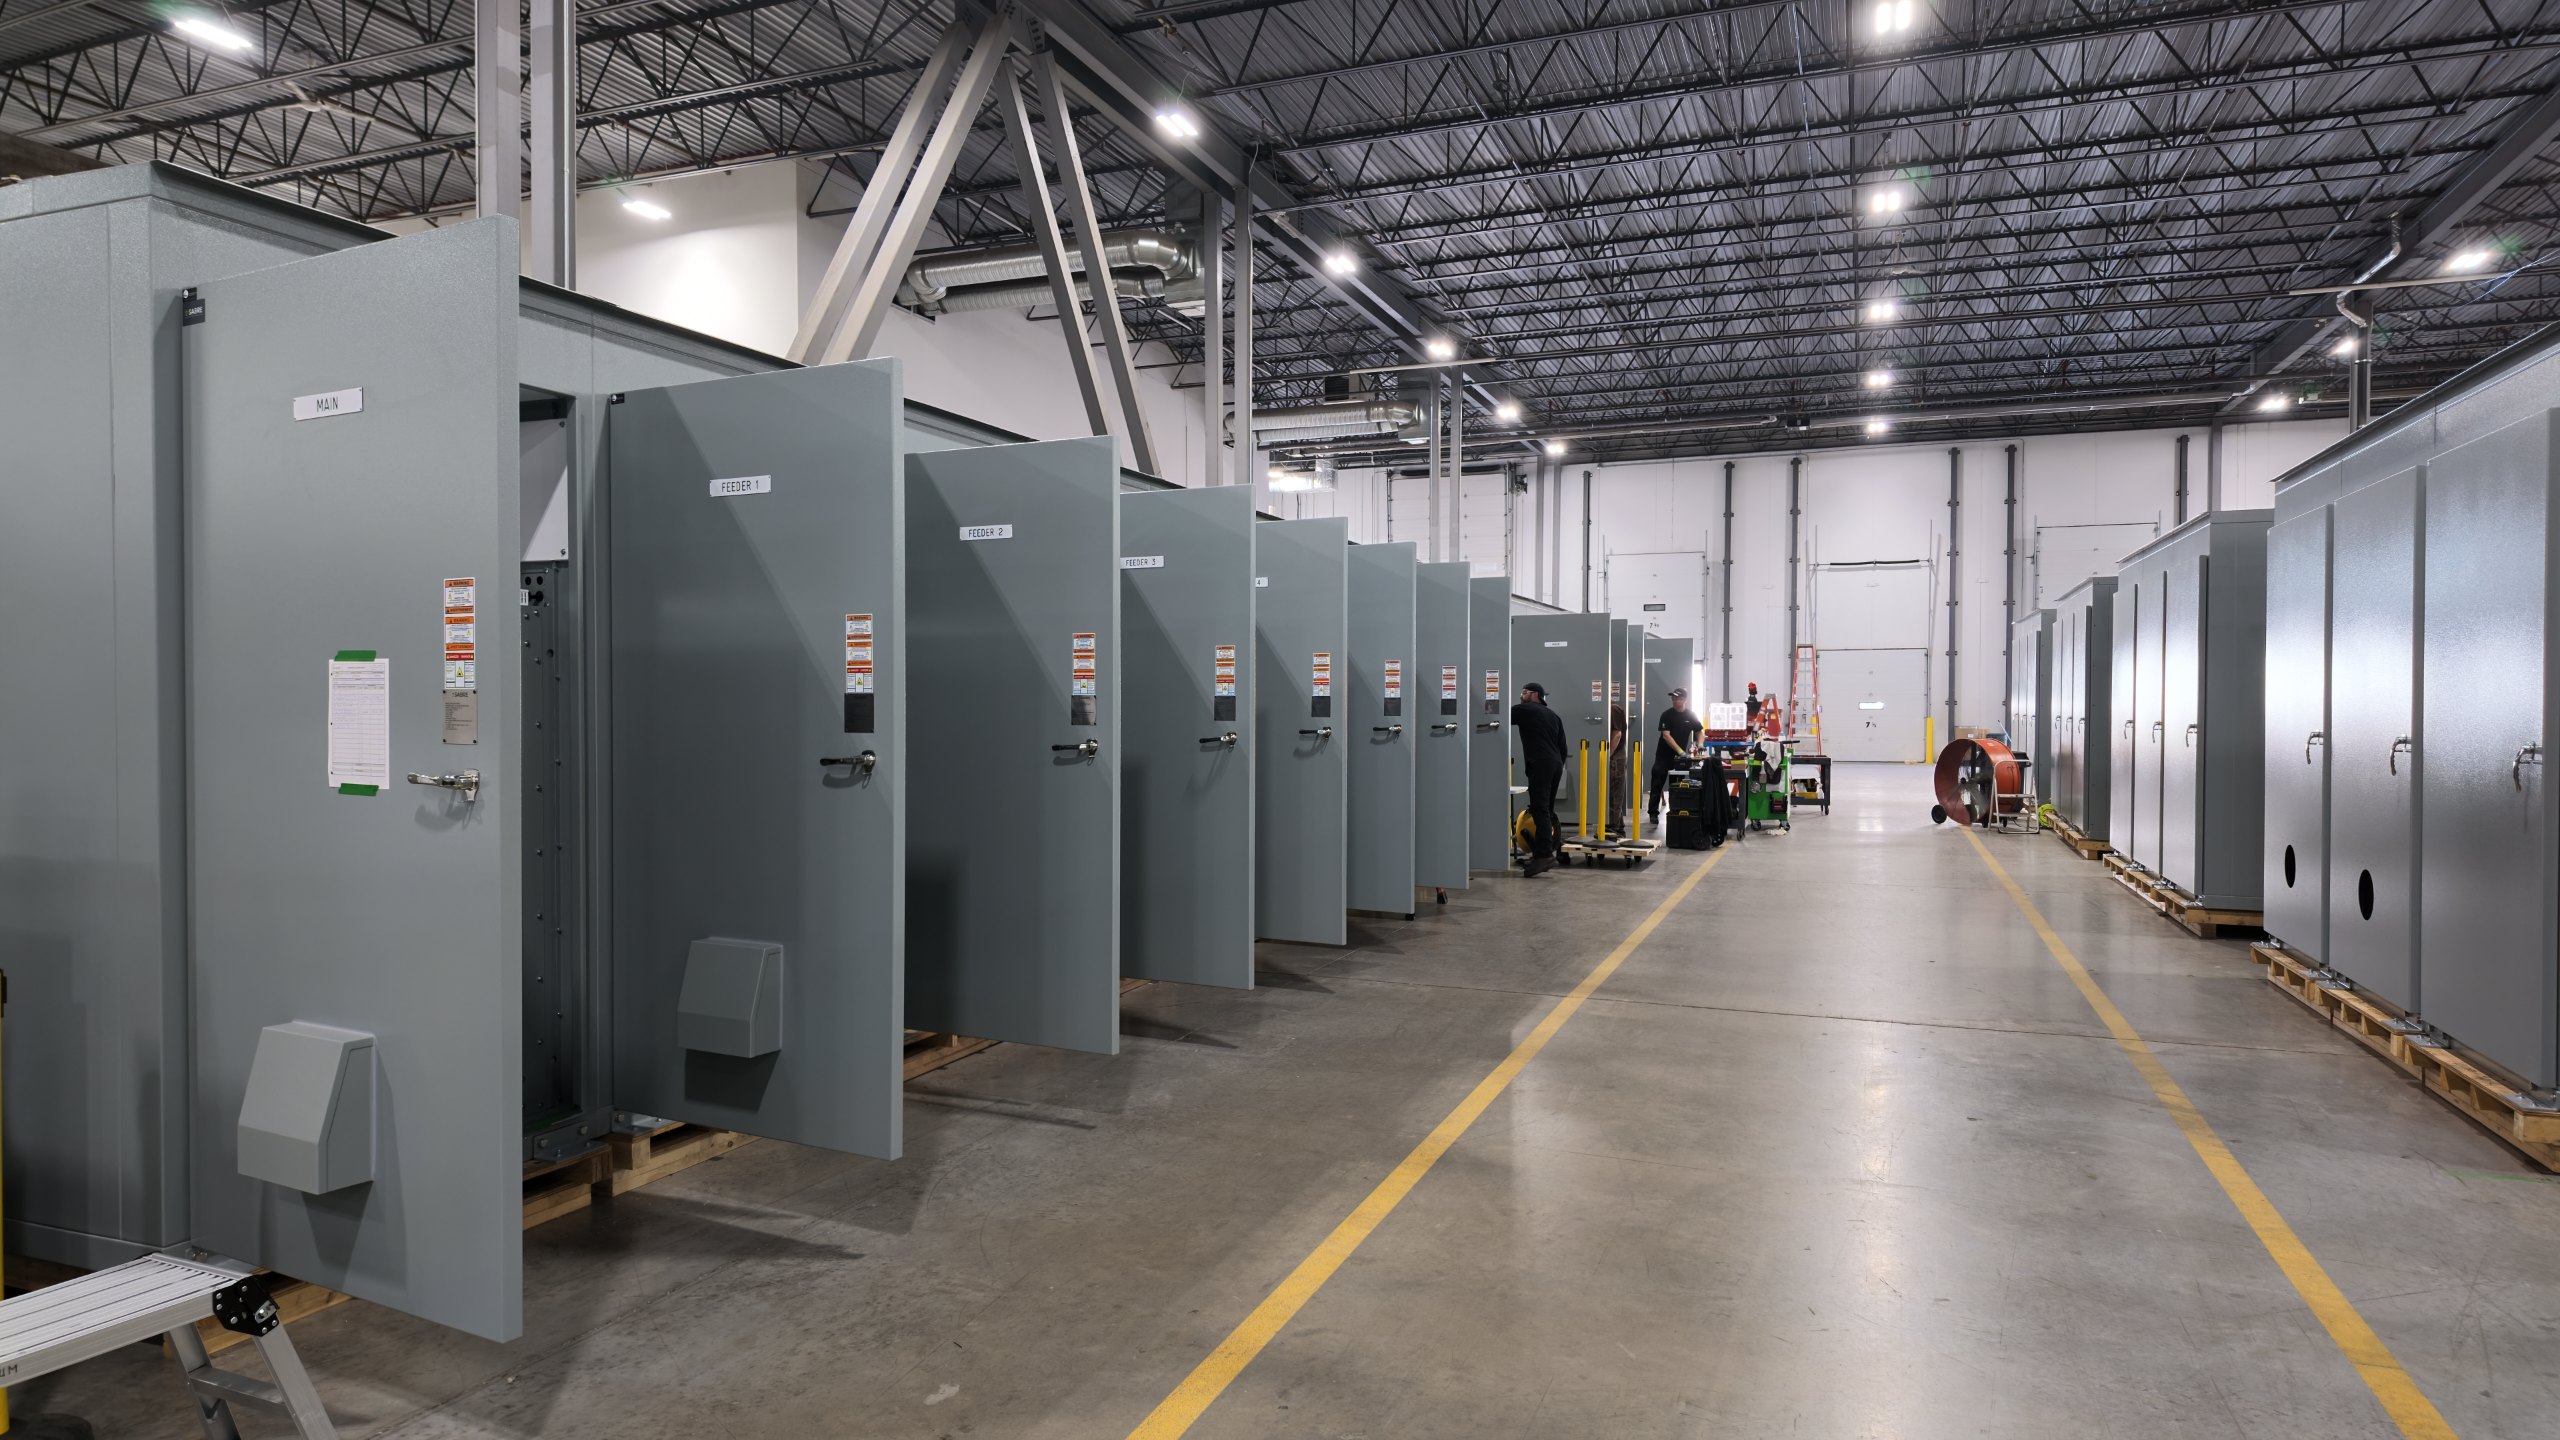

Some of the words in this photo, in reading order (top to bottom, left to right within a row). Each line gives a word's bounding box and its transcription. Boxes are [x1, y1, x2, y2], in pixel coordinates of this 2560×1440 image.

[188, 306, 203, 316] SABRE
[316, 396, 339, 413] MAIN
[721, 480, 752, 493] FEEDER
[755, 480, 759, 491] 1
[968, 527, 995, 538] FEEDER
[998, 527, 1004, 536] 2
[1125, 558, 1149, 567] FEEDER
